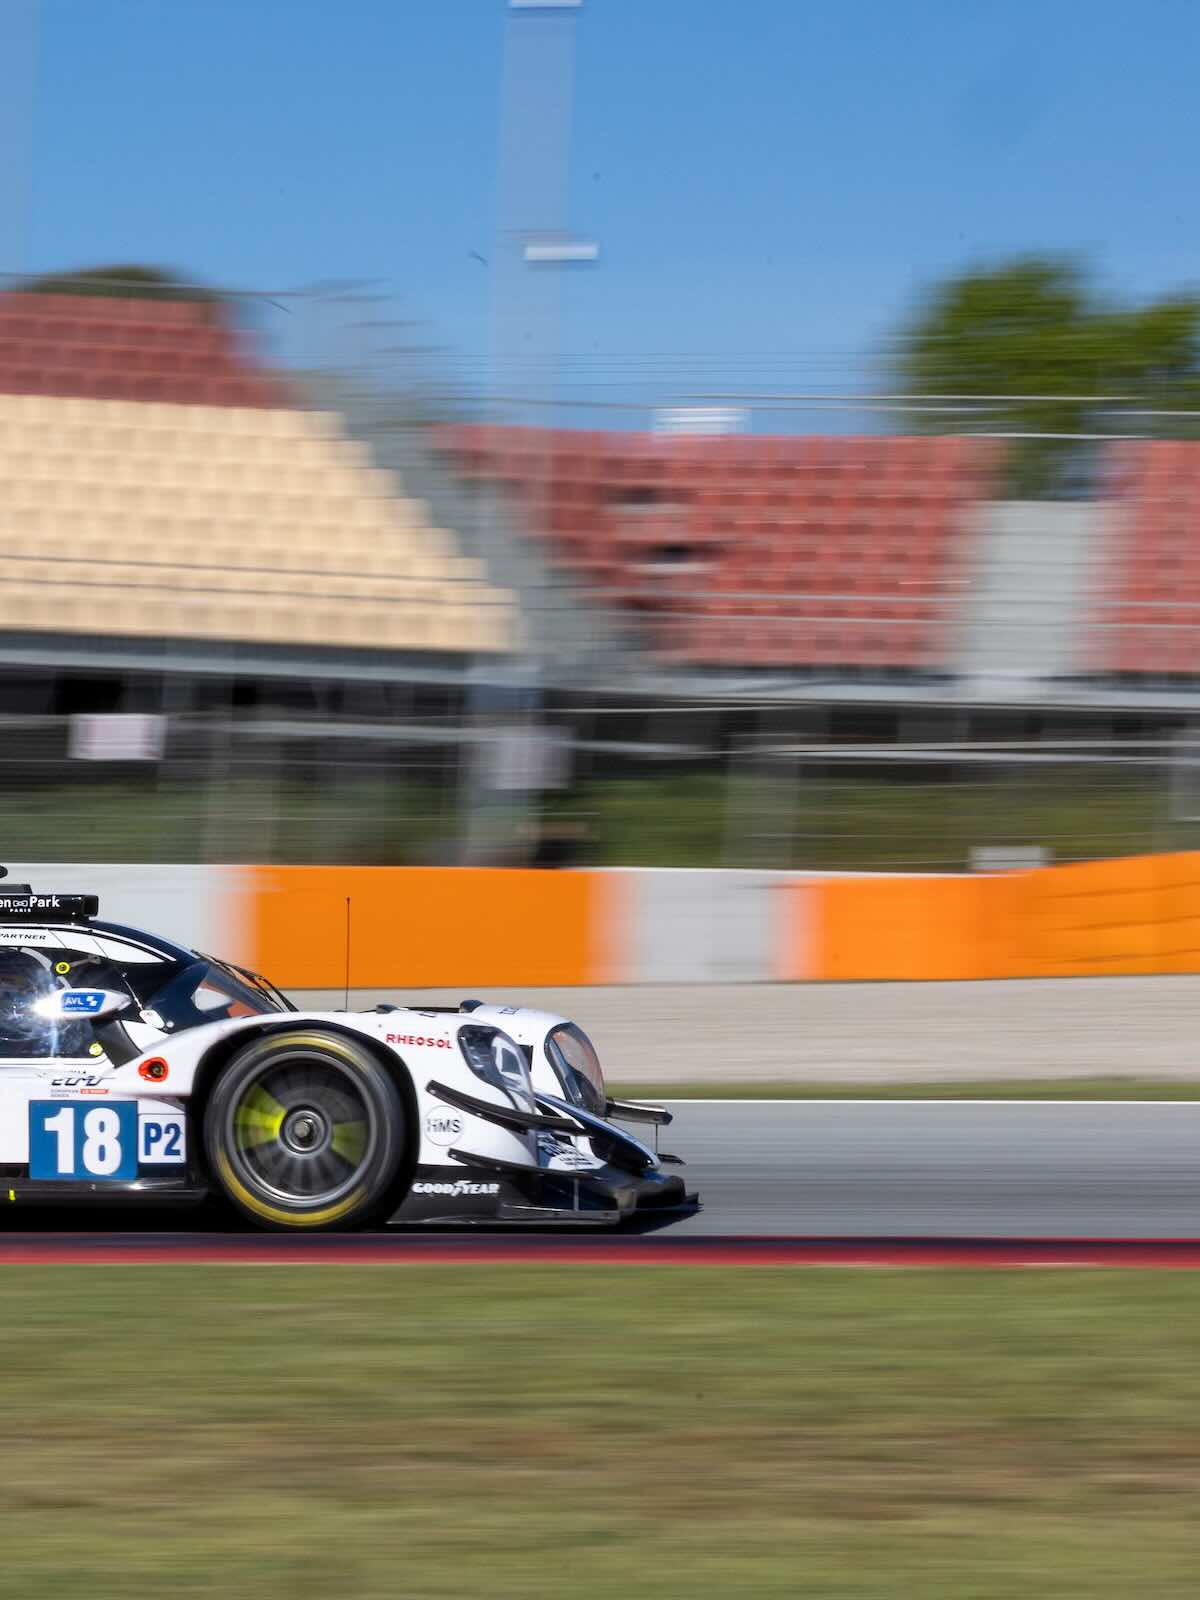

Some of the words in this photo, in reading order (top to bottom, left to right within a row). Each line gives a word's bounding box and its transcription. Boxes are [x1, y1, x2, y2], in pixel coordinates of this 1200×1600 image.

[29, 895, 60, 908] Park
[386, 1033, 452, 1049] RHEOSOL
[44, 1107, 123, 1176] 18
[144, 1122, 182, 1156] P2
